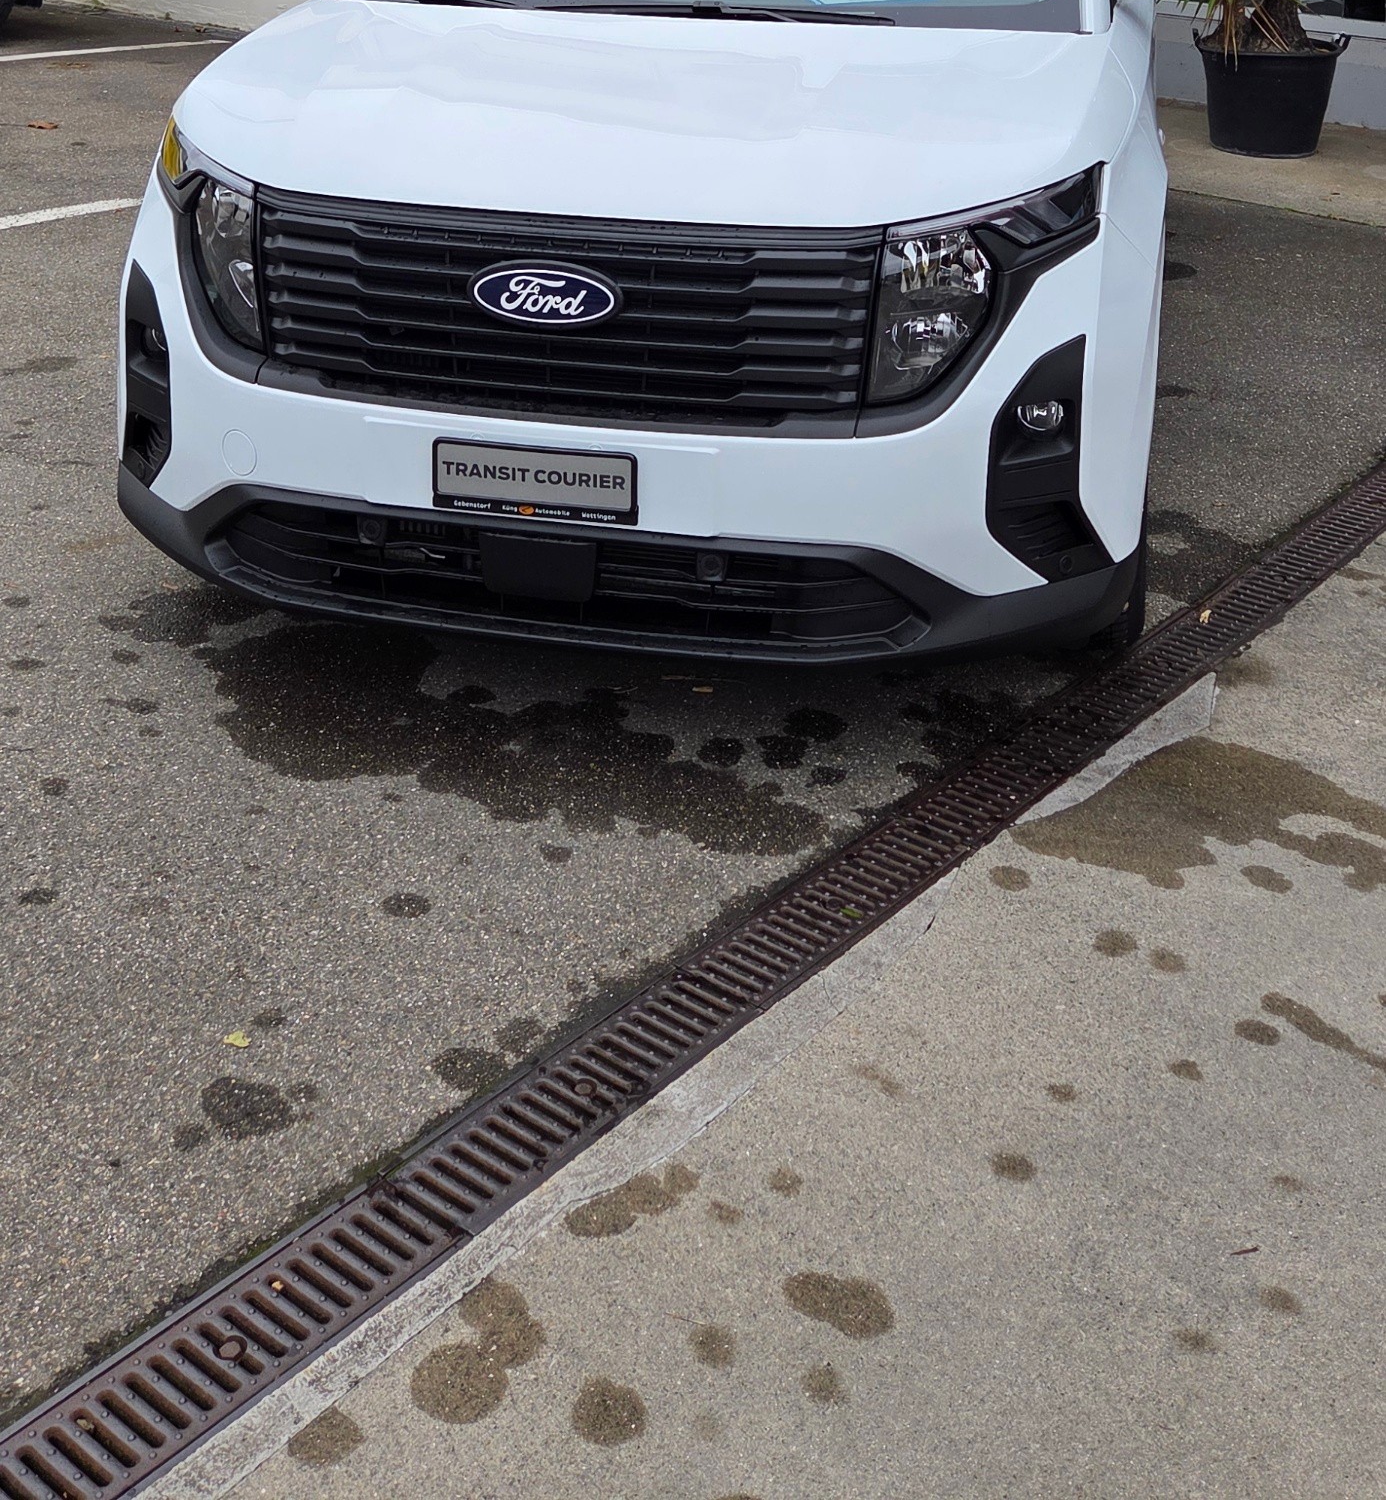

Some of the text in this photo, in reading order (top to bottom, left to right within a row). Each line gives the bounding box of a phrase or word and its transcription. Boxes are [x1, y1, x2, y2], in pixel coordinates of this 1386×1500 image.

[500, 275, 588, 316] Ford
[442, 460, 626, 491] TRANSIT COURIER
[501, 504, 518, 513] Küng
[534, 507, 570, 517] Automobile
